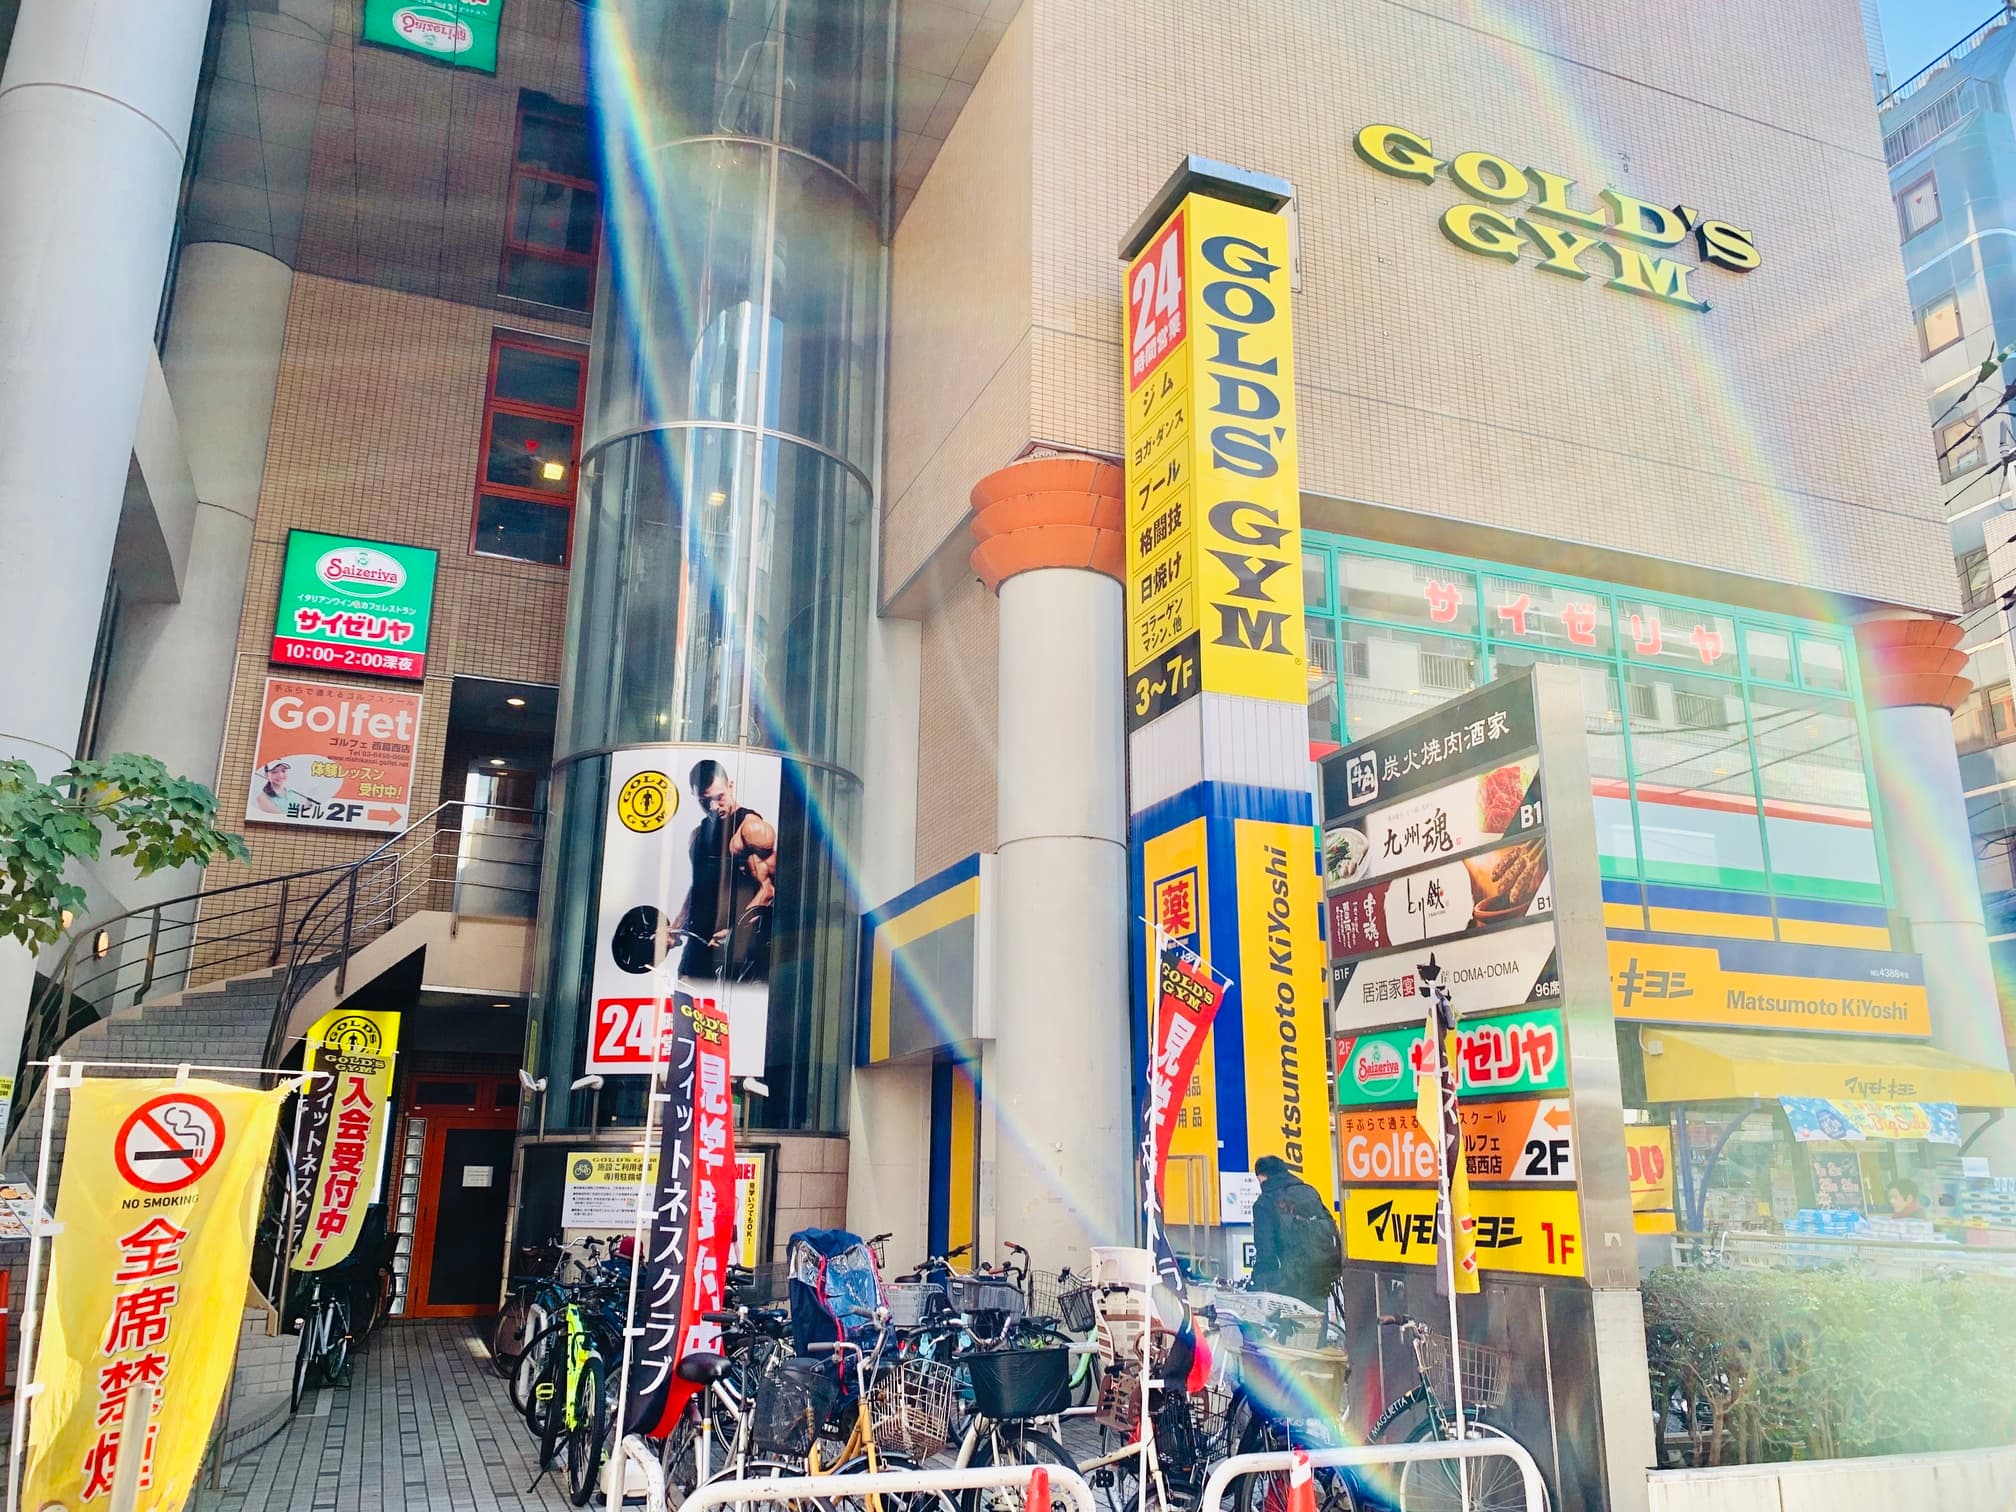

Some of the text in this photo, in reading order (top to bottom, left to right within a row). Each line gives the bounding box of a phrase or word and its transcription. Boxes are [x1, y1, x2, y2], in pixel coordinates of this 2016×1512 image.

[1353, 123, 1762, 273] GOLD'S
[1439, 203, 1715, 314] GYM
[1133, 229, 1182, 355] 24
[1143, 370, 1174, 417] ジム
[1201, 235, 1294, 656] GOLD'S GYM
[1138, 458, 1181, 512] プール
[1139, 501, 1183, 559] 格闘技
[324, 558, 398, 583] Saizeriya
[1141, 550, 1183, 605] 日焼け
[296, 609, 412, 643] サイゼリヤ
[1141, 597, 1184, 638] コラーゲン
[1424, 580, 1722, 665] サイゼリヤ
[269, 696, 413, 741] Golfet
[328, 736, 368, 749] ゴルフェ
[311, 761, 385, 780] 体験レッスン
[358, 782, 402, 799] 受付中!
[286, 802, 364, 822] 当ビル 2F
[1383, 808, 1454, 858] 九州魂
[1162, 880, 1190, 935] 薬
[1264, 845, 1293, 976] KiYoshi
[1161, 962, 1214, 1006] GOLD'S
[1334, 968, 1351, 981] B1F
[1454, 960, 1520, 985] DOMA-DOMA
[1609, 957, 1694, 1008] キヨシ
[1162, 980, 1202, 1012] GYM
[1727, 989, 1909, 1021] Matsumoto KiYoshi
[329, 1020, 377, 1044] GOLD'S
[599, 1004, 655, 1057] 24
[693, 1020, 721, 1046] GM
[1338, 1041, 1351, 1056] 2F
[325, 1055, 385, 1069] GOLD'S
[335, 1063, 377, 1075] GYM
[1358, 1058, 1400, 1083] Saizeriya
[1844, 1076, 1918, 1099] マツモトキヨシ
[1347, 1131, 1435, 1178] Golfe
[1464, 1134, 1501, 1152] ルフェ
[1525, 1139, 1570, 1176] 2F
[304, 1076, 374, 1267] 入会受付中!
[1465, 1155, 1503, 1175] 葛西店
[121, 1193, 199, 1209] NO SMOKING
[639, 1036, 698, 1396] フィットネスクラブ
[1541, 1221, 1575, 1265] 1F
[1371, 1396, 1408, 1438] MAGLIETTA
